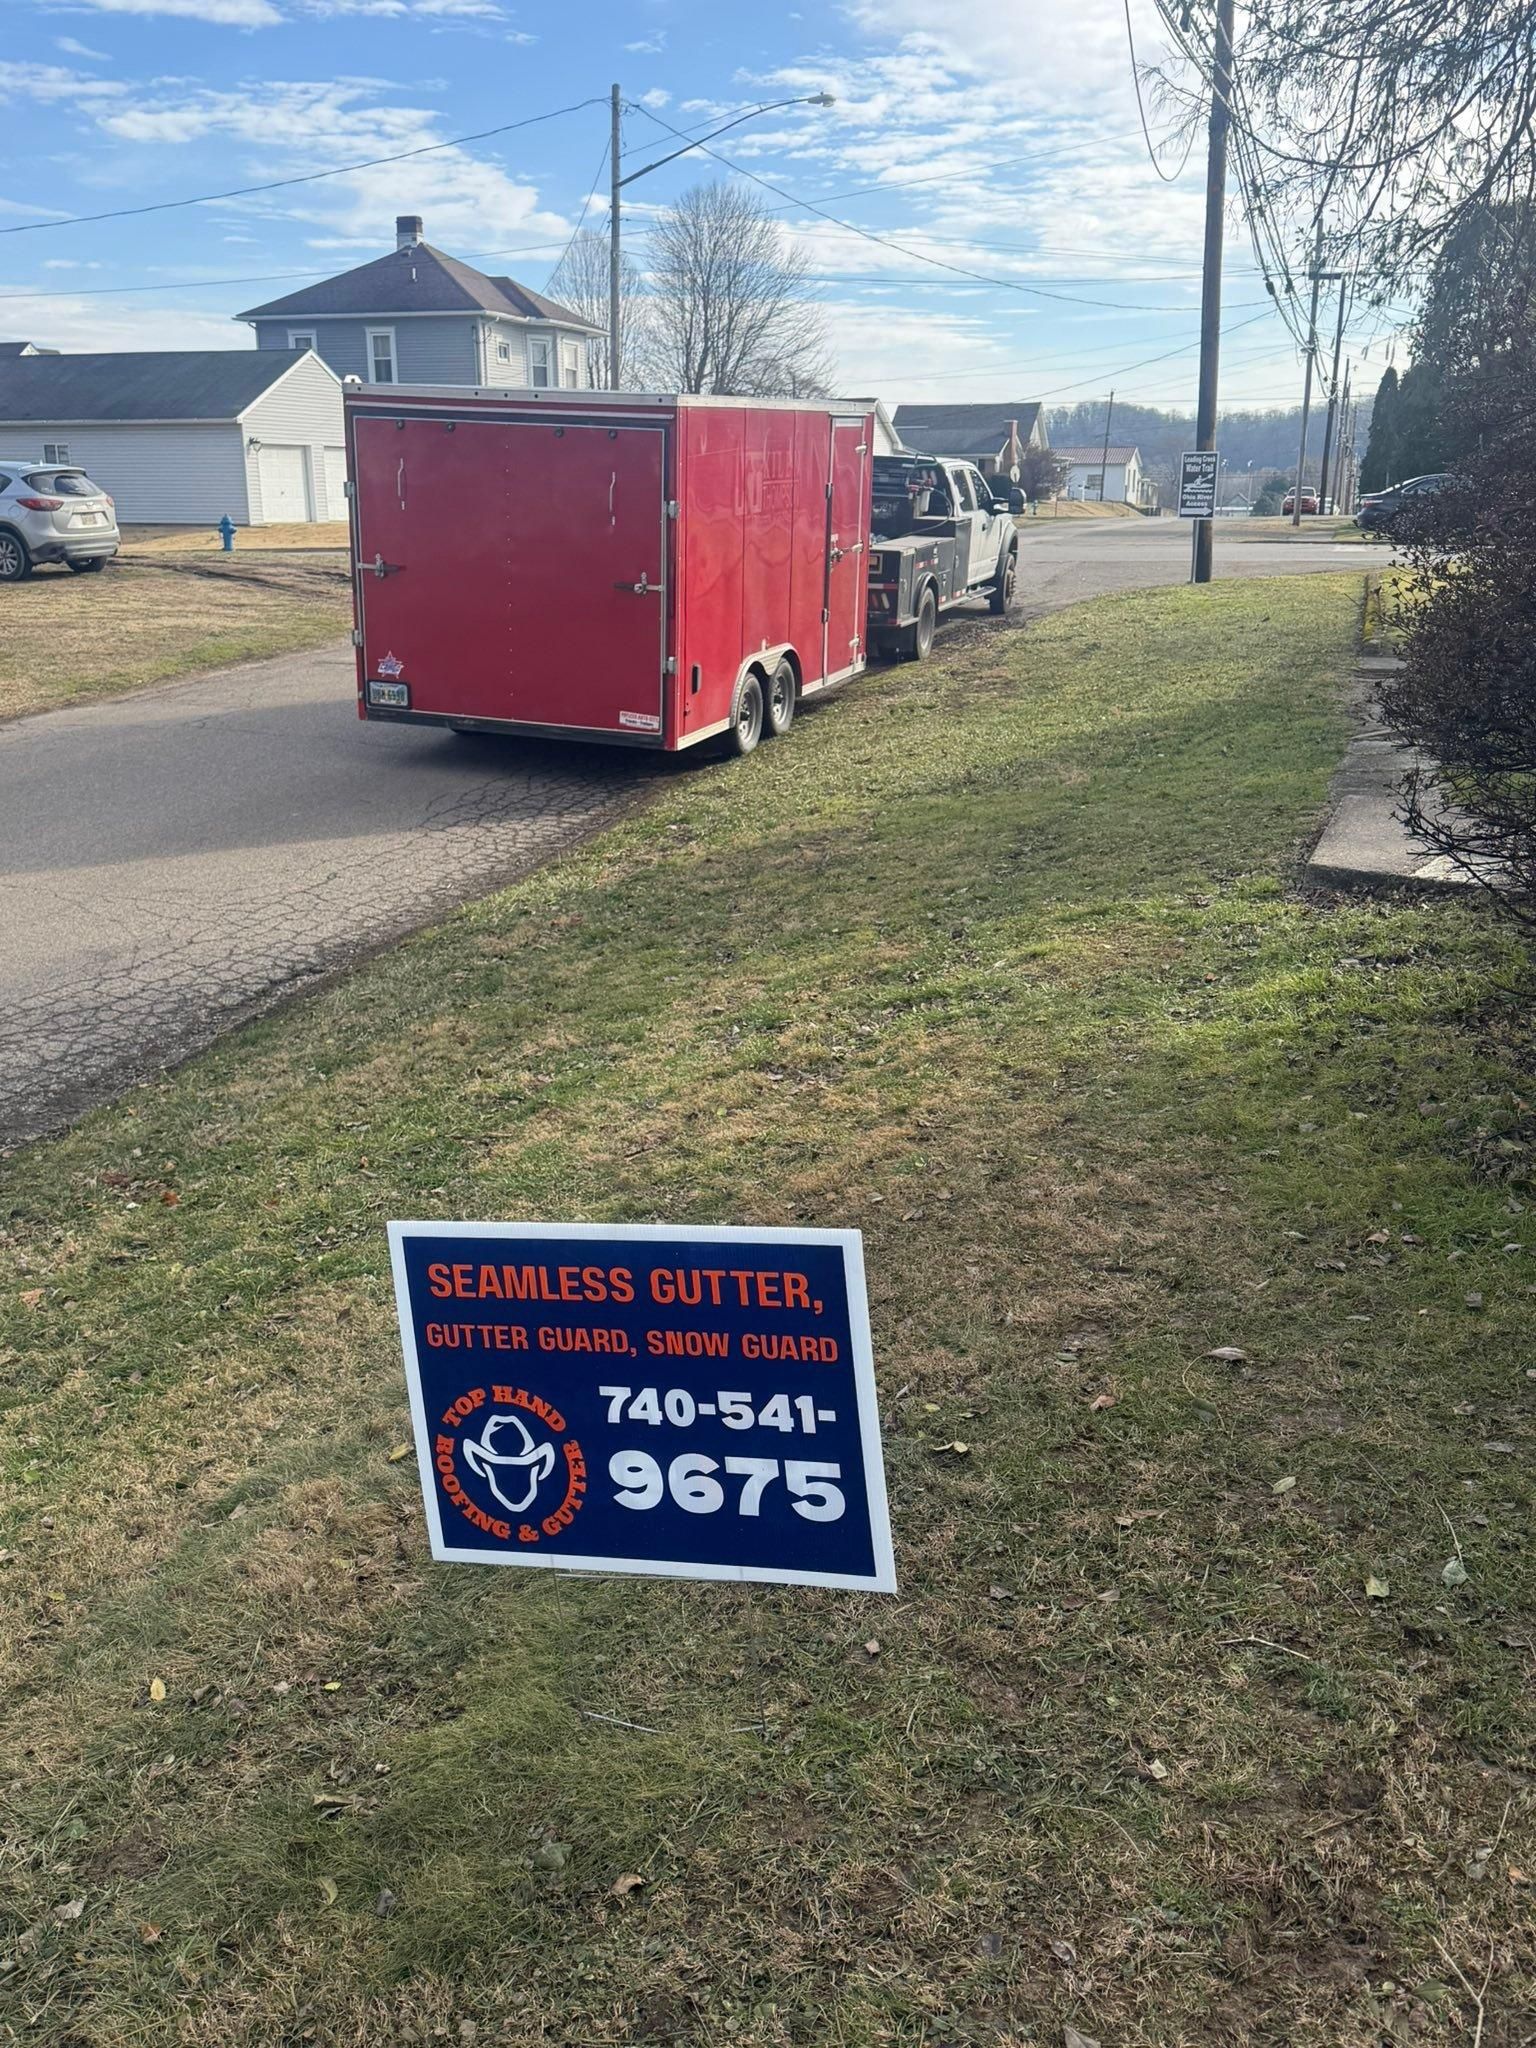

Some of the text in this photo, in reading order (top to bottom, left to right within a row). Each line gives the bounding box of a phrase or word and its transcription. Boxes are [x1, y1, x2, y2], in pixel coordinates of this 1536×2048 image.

[1184, 455, 1216, 464] Leading Creek
[1186, 463, 1214, 472] Water Trail
[427, 1263, 823, 1315] SEAMLESS GUTTER,
[426, 1323, 838, 1362] GUTTER GUARD, SNOW GUARD
[442, 1385, 567, 1432] TOP HAND
[598, 1385, 837, 1434] 740-541-
[435, 1434, 587, 1542] ROOFING & GUTTER
[608, 1449, 846, 1522] 9675
